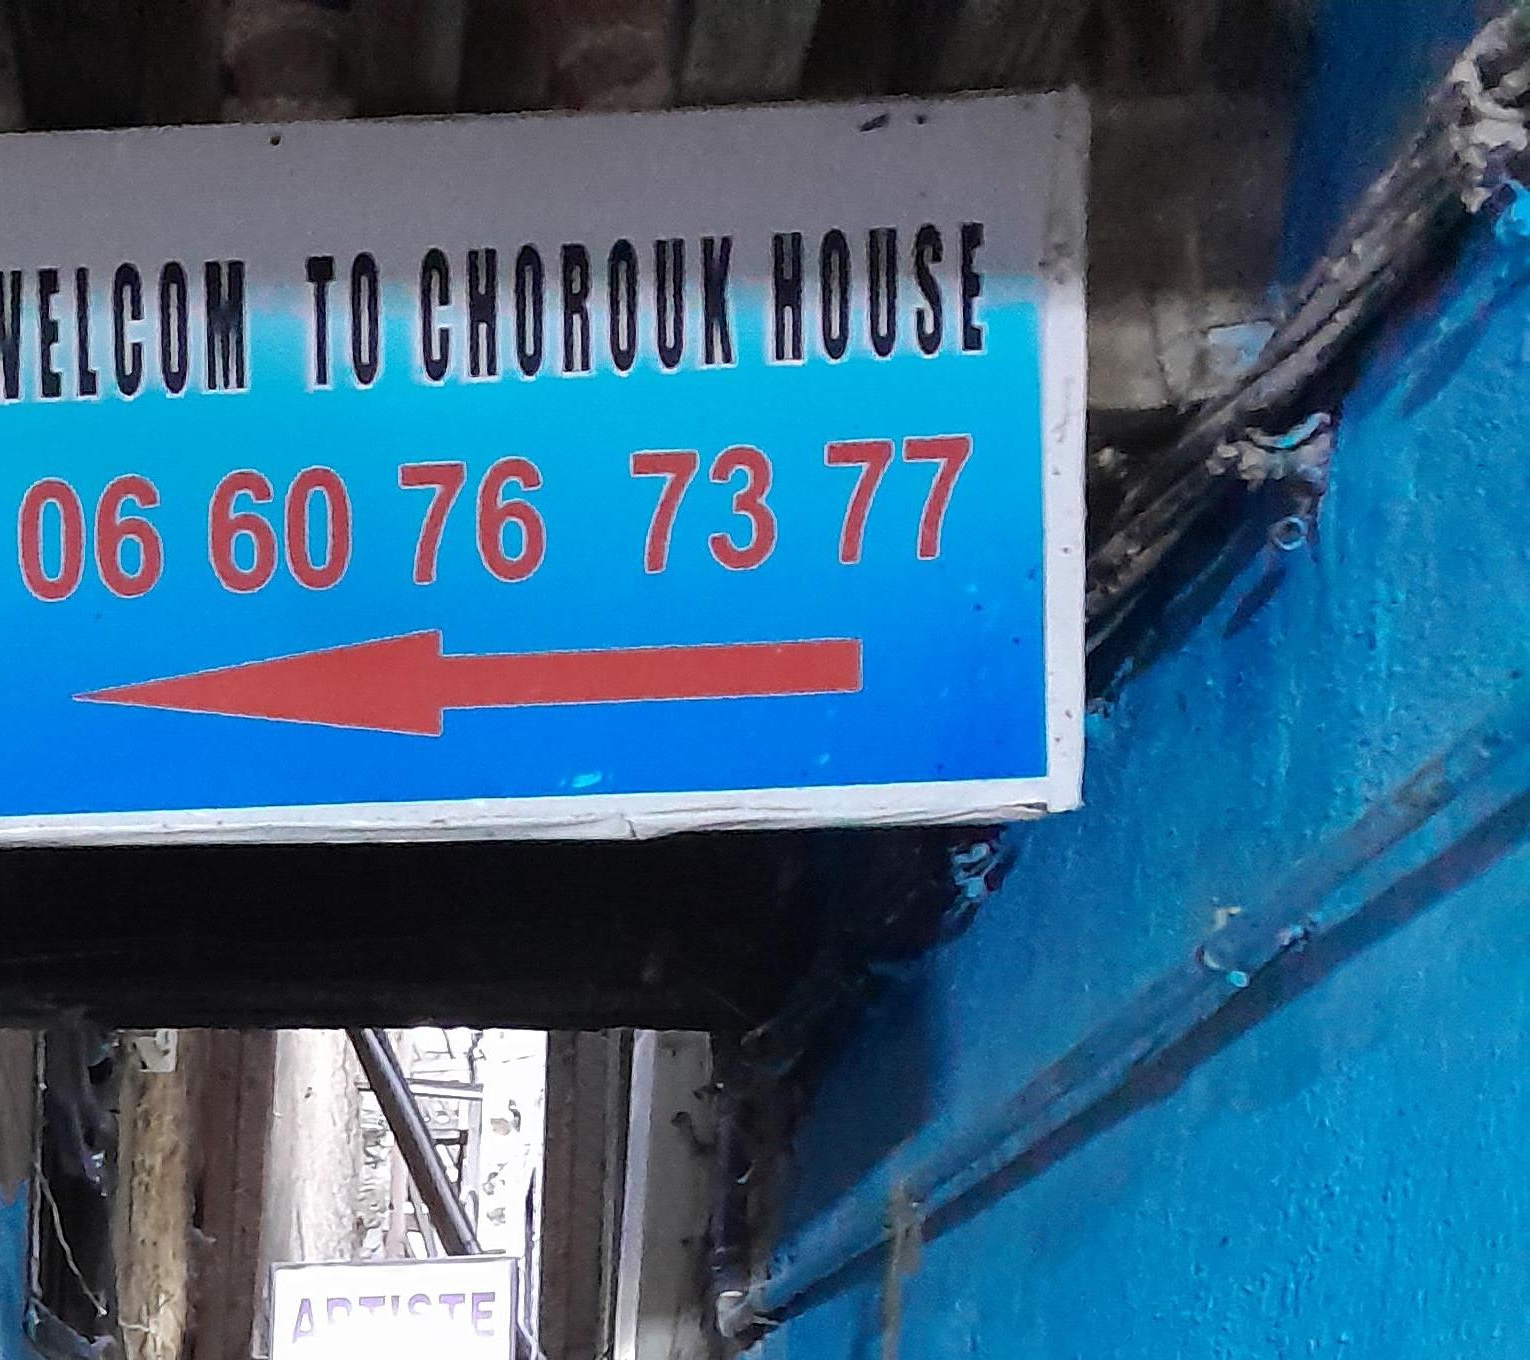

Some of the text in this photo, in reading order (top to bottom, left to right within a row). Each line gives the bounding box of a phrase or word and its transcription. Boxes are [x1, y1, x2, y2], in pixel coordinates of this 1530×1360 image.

[304, 251, 382, 385] TO
[419, 235, 734, 380] CHOROUK
[771, 222, 986, 361] HOUSE
[19, 434, 972, 600] 06 60 76 73 77
